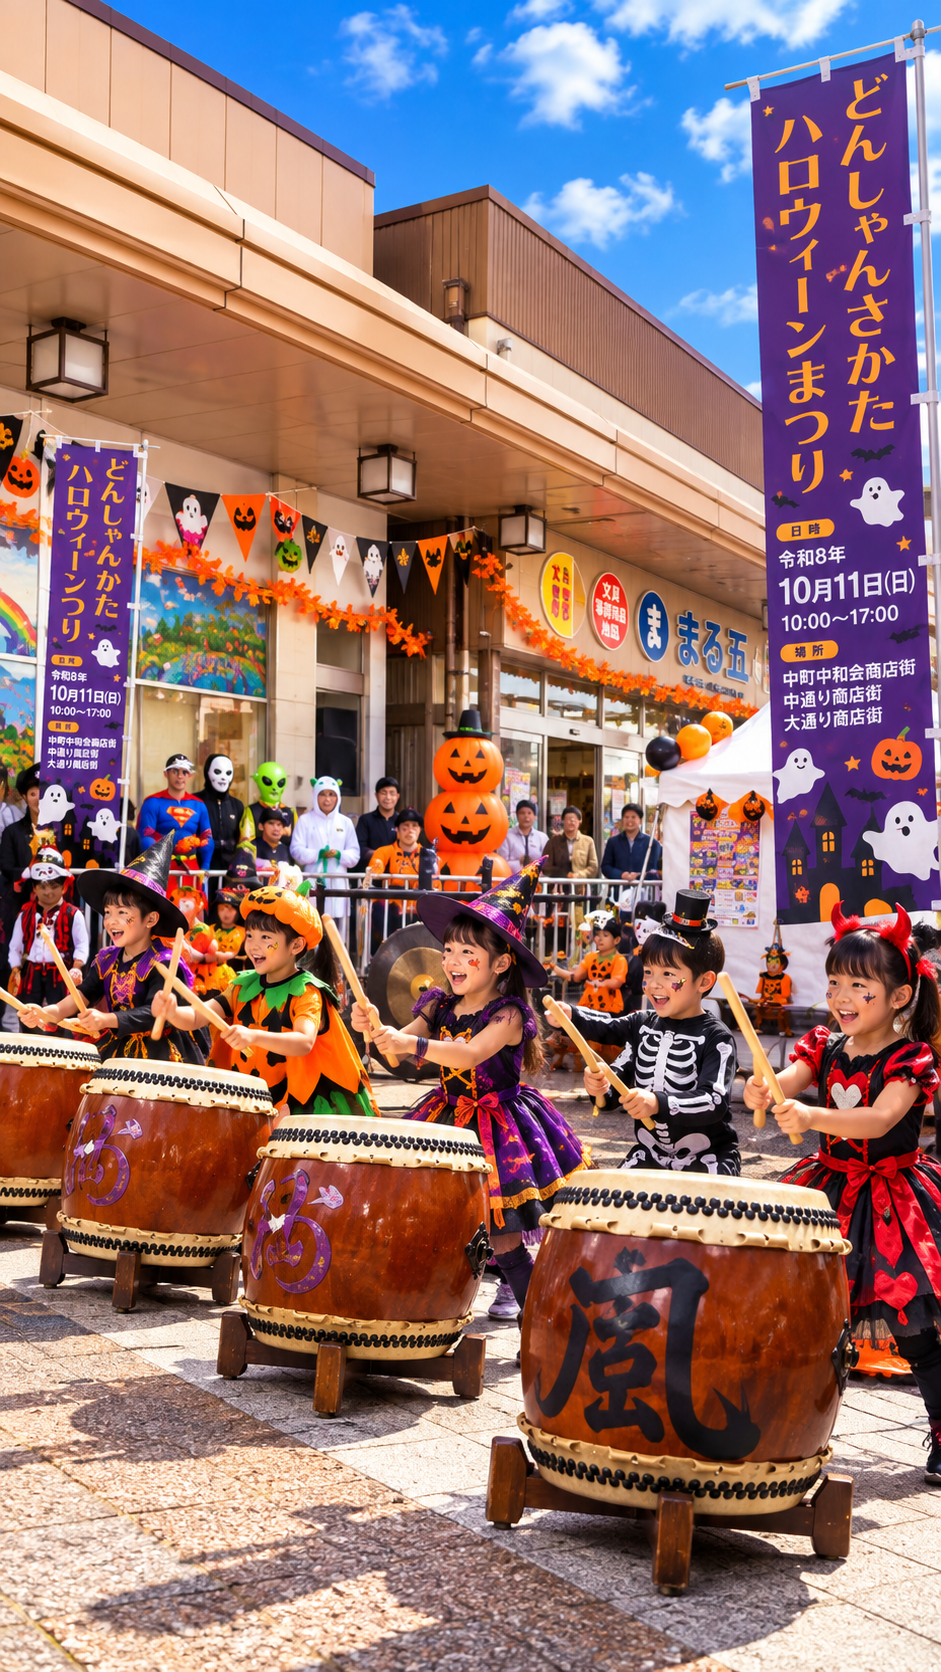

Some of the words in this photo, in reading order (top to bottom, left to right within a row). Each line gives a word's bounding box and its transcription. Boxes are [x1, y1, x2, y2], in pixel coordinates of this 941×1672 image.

[840, 73, 896, 434] どんしゃんさかた
[775, 114, 829, 494] ハロウィーンまつり
[61, 465, 93, 642] ハロウィーンつり
[95, 458, 129, 618] どんしゃんかた
[778, 546, 846, 569] 令和8年
[778, 568, 915, 605] 10月11日(日)
[646, 603, 662, 649] ま
[676, 609, 750, 684] まる五
[50, 684, 121, 706] 10月11日(日)
[783, 658, 916, 688] 中町中和会商店街
